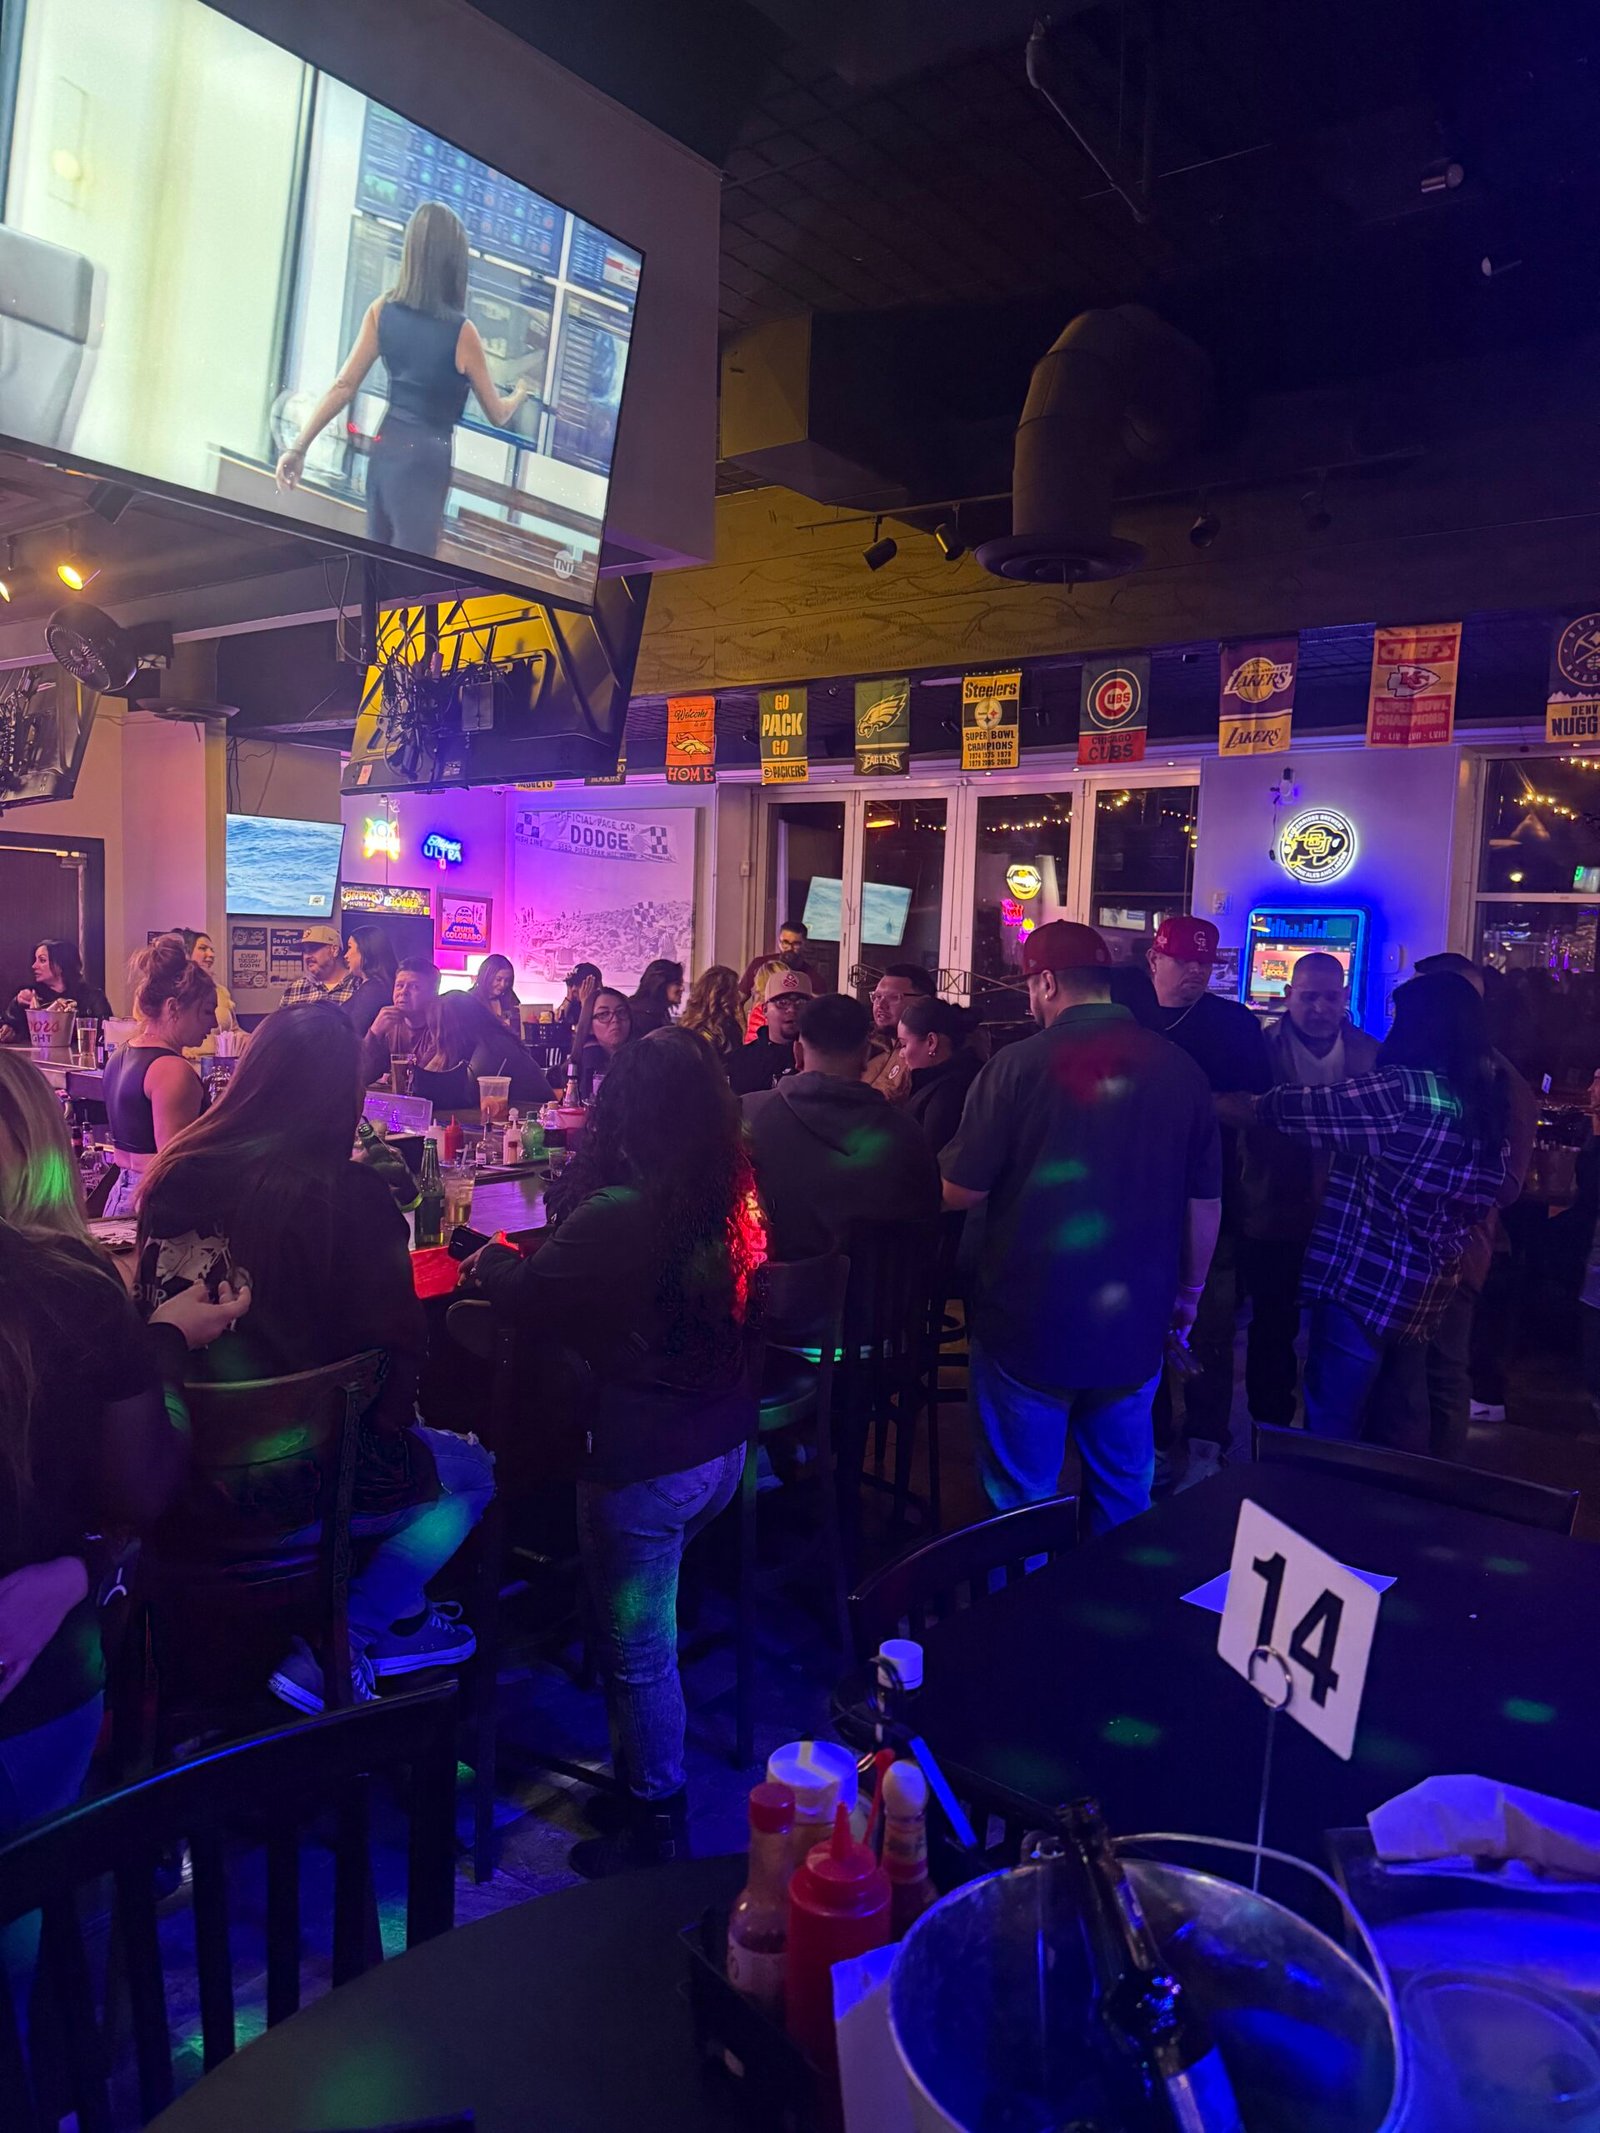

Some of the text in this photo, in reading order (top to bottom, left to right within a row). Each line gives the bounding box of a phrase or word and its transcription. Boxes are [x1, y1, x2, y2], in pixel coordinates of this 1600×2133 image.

[1380, 640, 1453, 660] CHIEFS
[1229, 670, 1286, 690] LAKERS
[965, 681, 1017, 699] Steelers
[774, 694, 789, 711] GO
[1571, 704, 1599, 716] DENV
[762, 713, 803, 737] PACK
[1552, 716, 1599, 736] NUGG
[965, 730, 1015, 741] SUPER BOWL
[1092, 734, 1132, 745] CHICAGO
[1225, 726, 1281, 749] LAKERS
[772, 740, 788, 755] GO
[967, 741, 1013, 752] CHAMPIONS
[1088, 743, 1134, 761] CUBS
[860, 753, 900, 770] EAGLES
[667, 766, 714, 782] HOME
[773, 764, 806, 779] PACKERS
[619, 821, 636, 832] CAR
[570, 824, 629, 850] DODGE
[424, 844, 462, 862] ULTRA
[445, 931, 482, 940] COLORADO
[1252, 1552, 1344, 1709] 14
